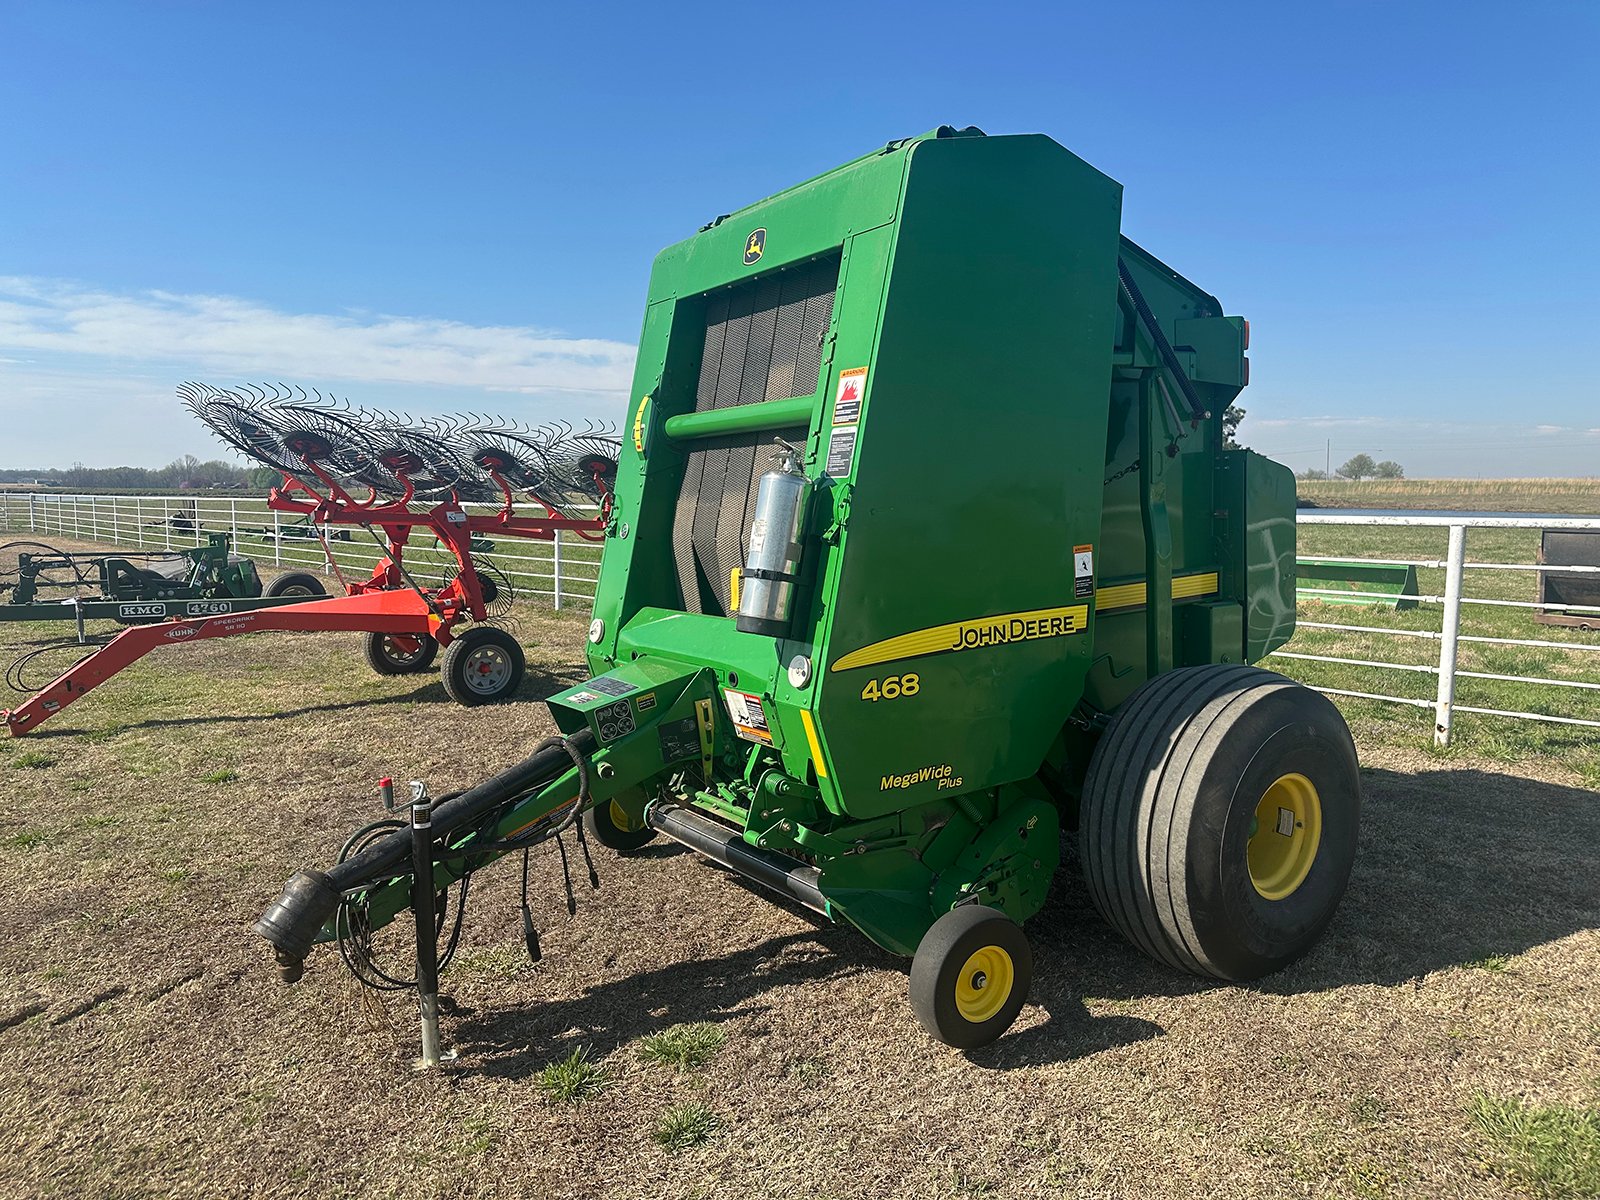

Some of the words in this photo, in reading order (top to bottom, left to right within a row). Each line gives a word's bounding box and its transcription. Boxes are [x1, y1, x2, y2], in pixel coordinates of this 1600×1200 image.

[123, 606, 162, 615] KMC
[191, 603, 228, 613] 4760
[213, 615, 255, 625] SPEEDRAKE
[168, 628, 194, 637] KUHN
[952, 624, 1007, 650] JOHN
[1009, 615, 1076, 641] DEERE
[861, 673, 920, 702] 468
[880, 764, 952, 791] MegaWide
[937, 776, 963, 791] Plus
